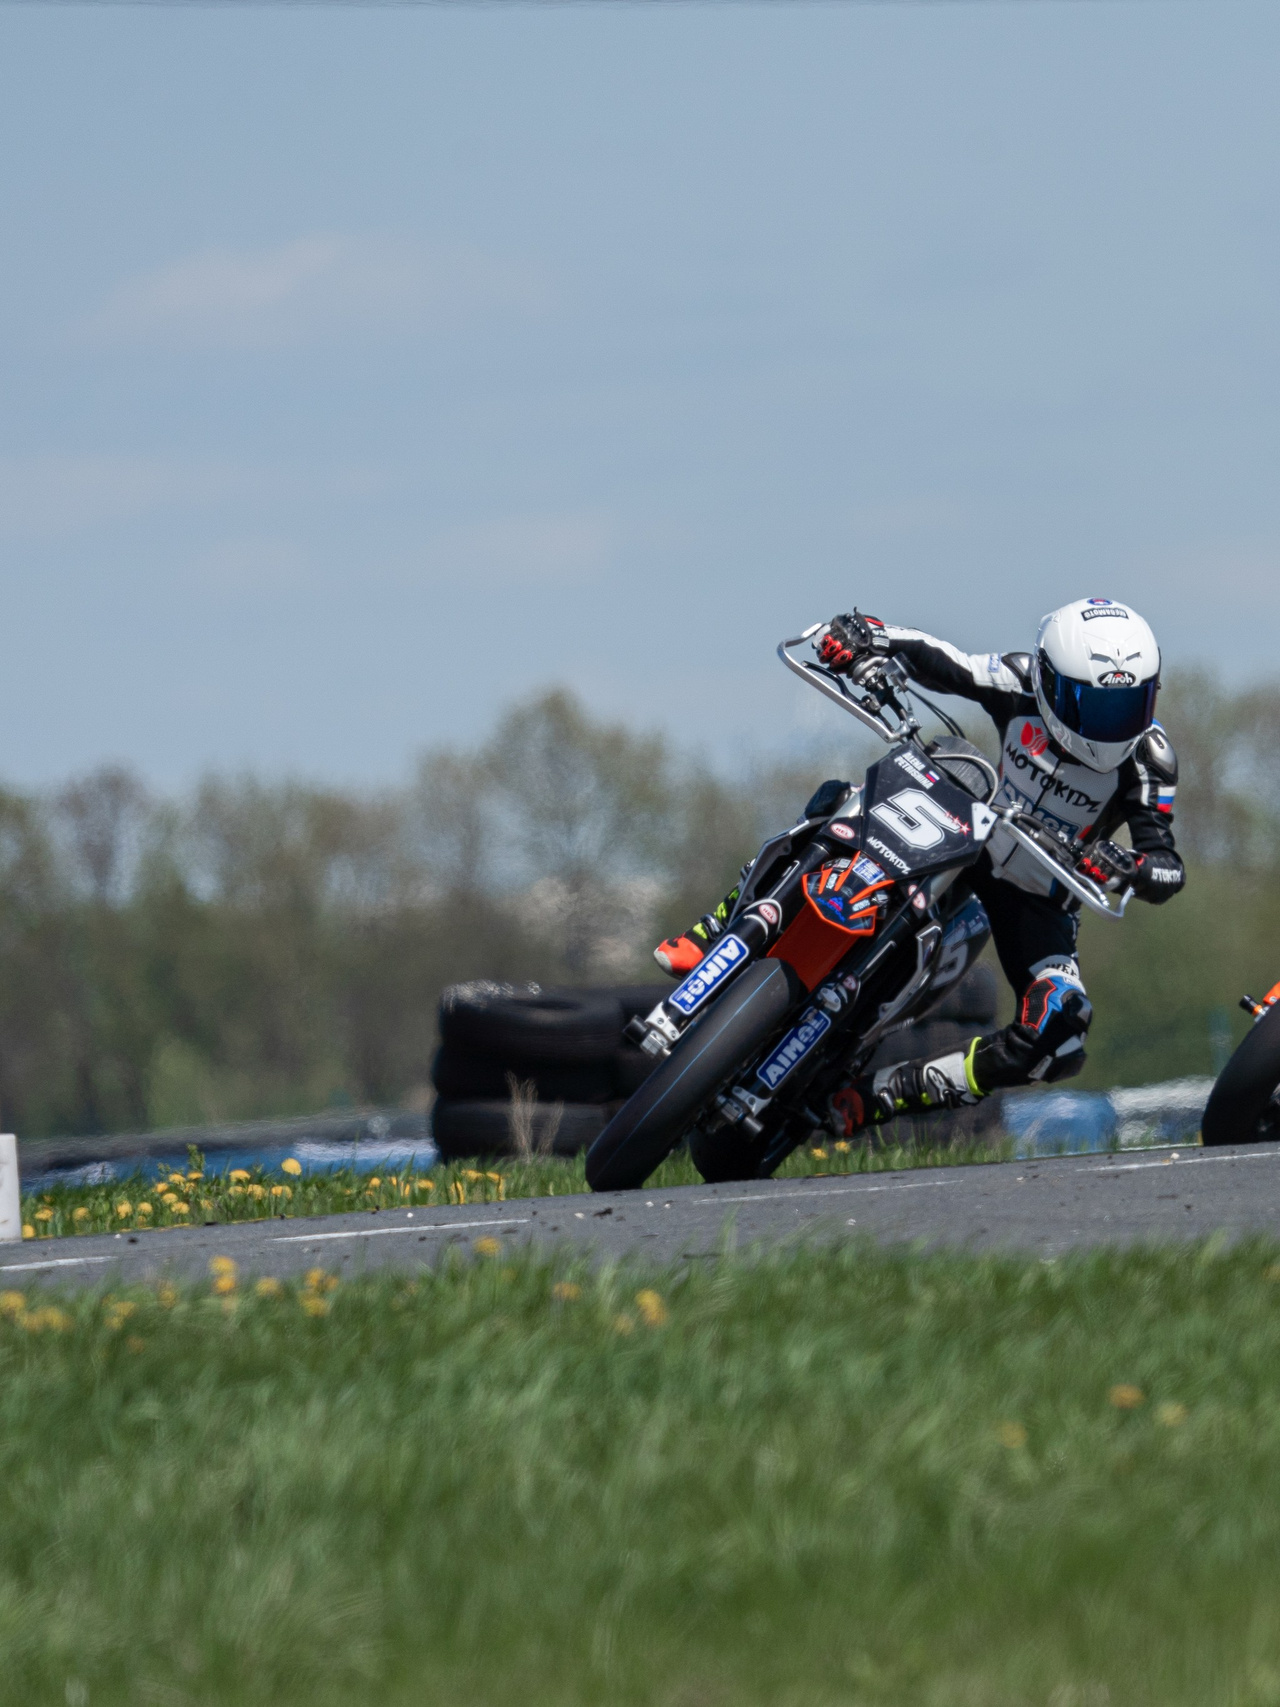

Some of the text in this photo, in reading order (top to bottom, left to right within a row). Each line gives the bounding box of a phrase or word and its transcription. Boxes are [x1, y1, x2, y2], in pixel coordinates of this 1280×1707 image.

[1101, 673, 1133, 684] Airoh
[902, 751, 926, 771] ALENA
[1006, 742, 1101, 813] MOTOKIDZ
[869, 787, 962, 850] 5
[866, 836, 912, 875] MOTOKIDZ
[676, 939, 741, 1004] AIMOL
[930, 923, 969, 991] 5
[766, 1018, 825, 1085] AIMOL
